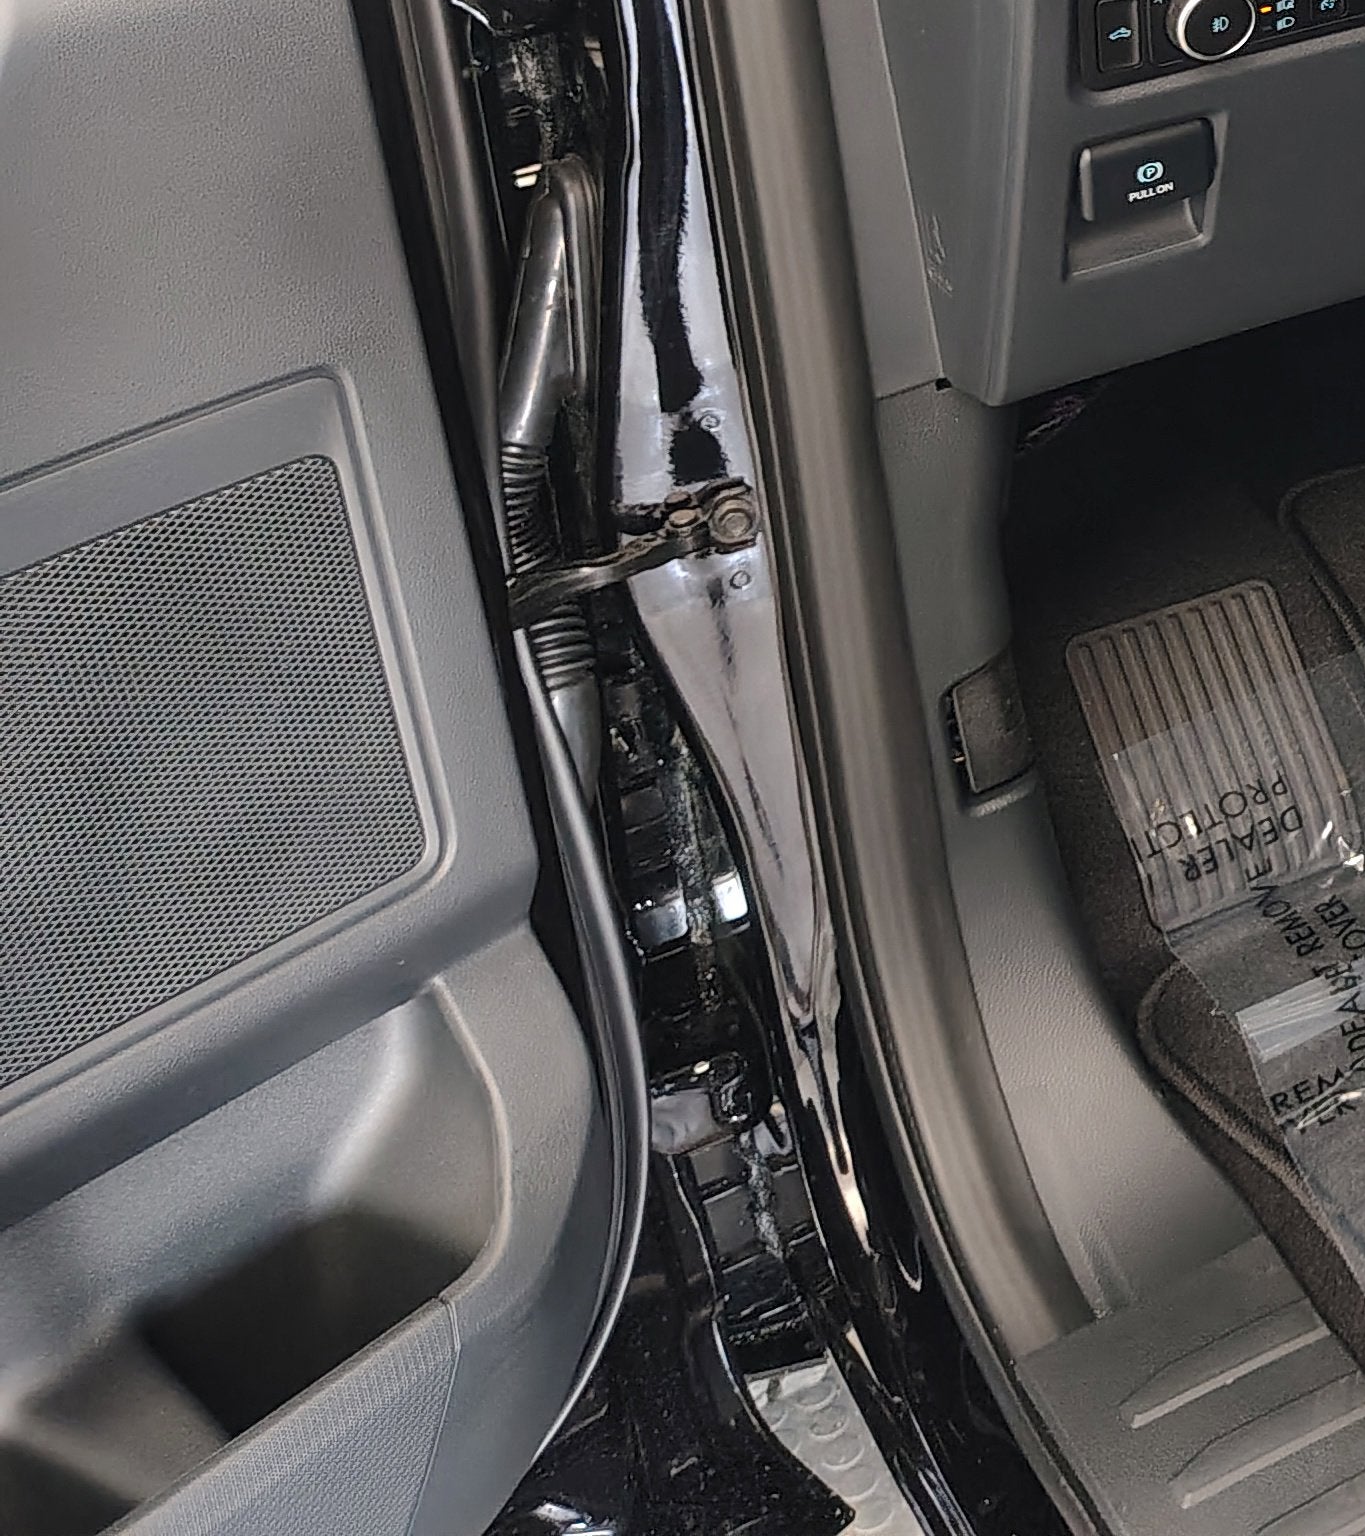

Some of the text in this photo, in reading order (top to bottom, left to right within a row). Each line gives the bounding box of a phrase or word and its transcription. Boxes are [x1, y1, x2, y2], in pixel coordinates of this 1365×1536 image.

[1128, 181, 1174, 203] PULL ON
[1178, 805, 1304, 882] DEALER
